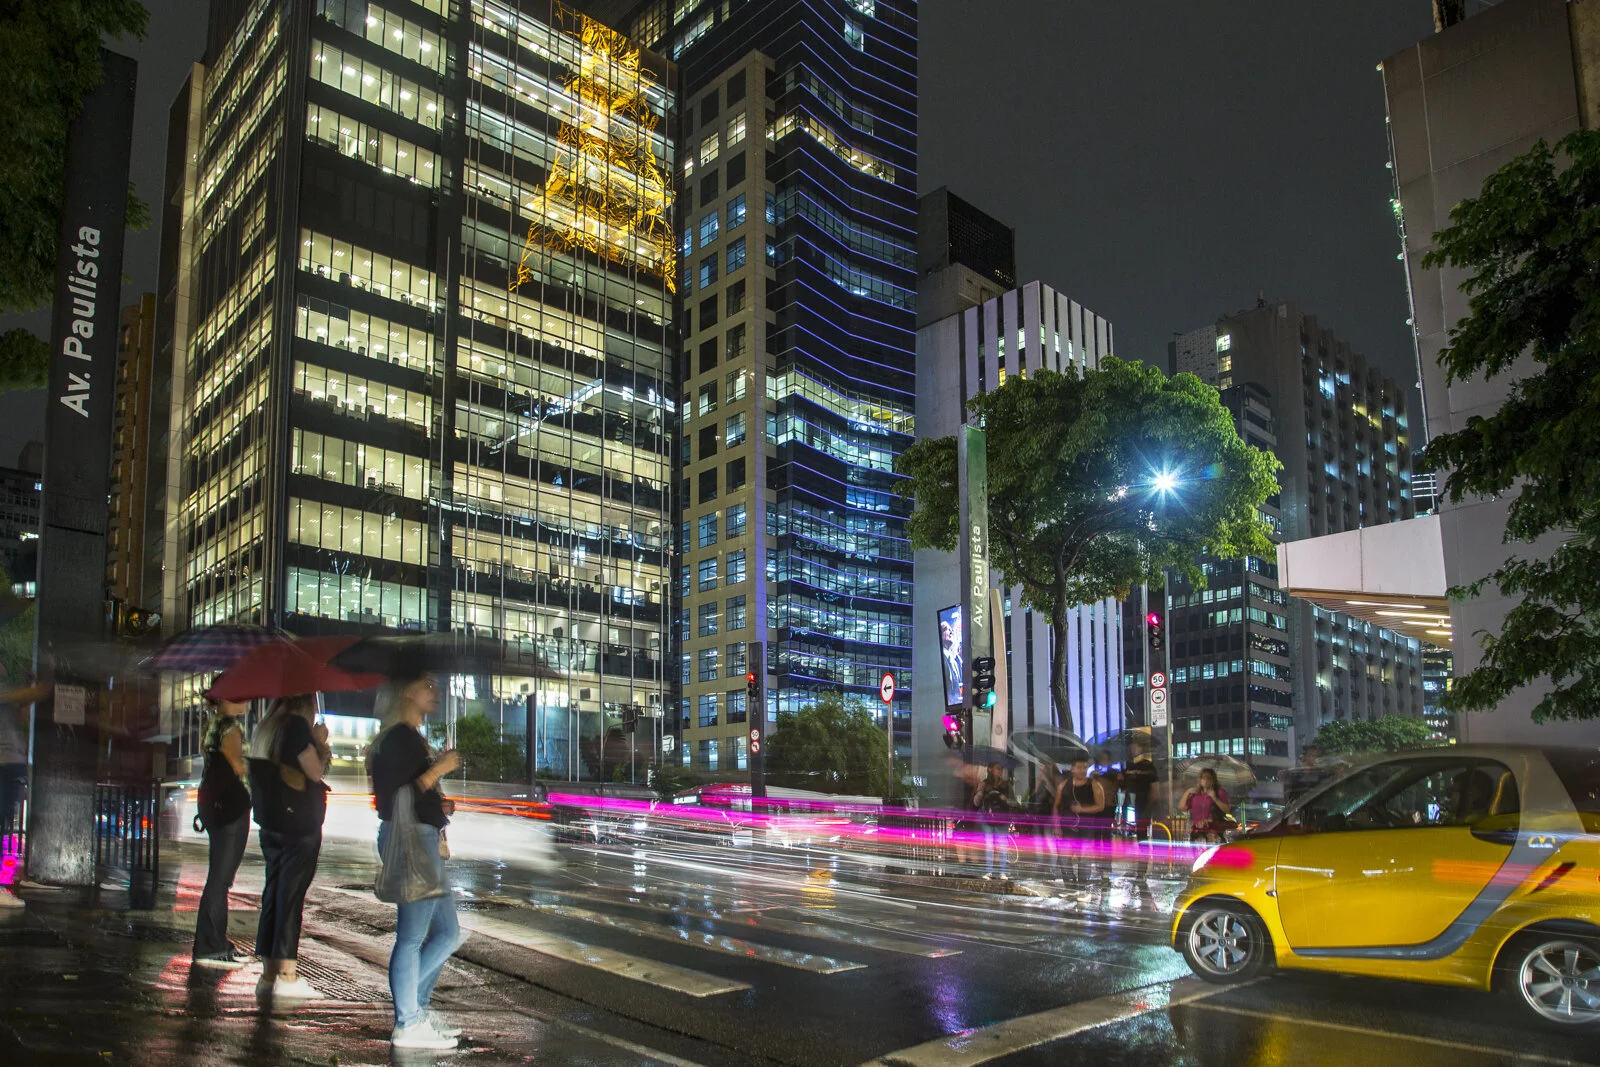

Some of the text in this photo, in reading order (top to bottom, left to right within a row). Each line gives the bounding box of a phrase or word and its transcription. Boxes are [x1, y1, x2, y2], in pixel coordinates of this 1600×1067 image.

[60, 224, 101, 419] Av. Paulista
[973, 525, 983, 628] Av. Paulista
[1152, 675, 1163, 684] 50
